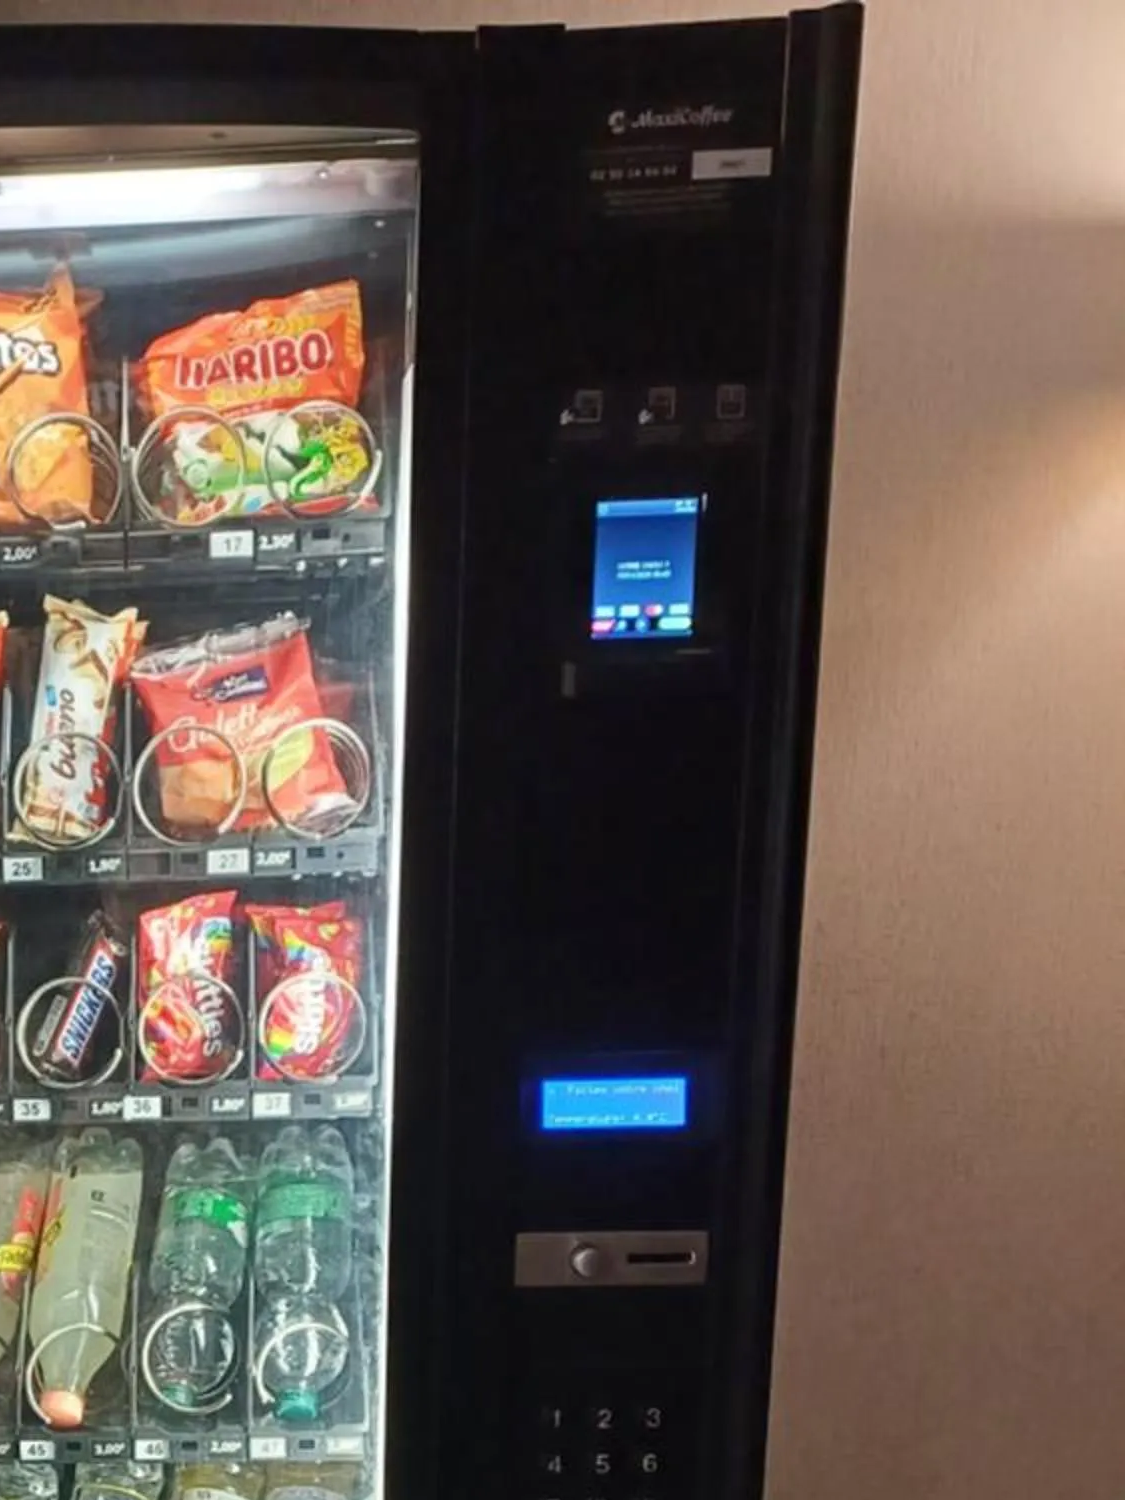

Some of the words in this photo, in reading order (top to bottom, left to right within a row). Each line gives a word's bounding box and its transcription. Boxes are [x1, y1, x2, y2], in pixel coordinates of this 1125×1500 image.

[175, 329, 334, 390] HARIBO
[224, 536, 243, 552] 17
[50, 688, 77, 780] bueno
[11, 862, 32, 877] 25
[60, 955, 116, 1060] SNICKERS
[21, 1102, 39, 1117] 35
[134, 1100, 152, 1114] 36
[553, 1408, 562, 1429] 1
[596, 1407, 612, 1429] 2
[645, 1407, 661, 1429] 3
[28, 1443, 45, 1456] 45
[547, 1454, 562, 1474] 4
[595, 1453, 611, 1475] 5
[642, 1453, 658, 1473] 6
